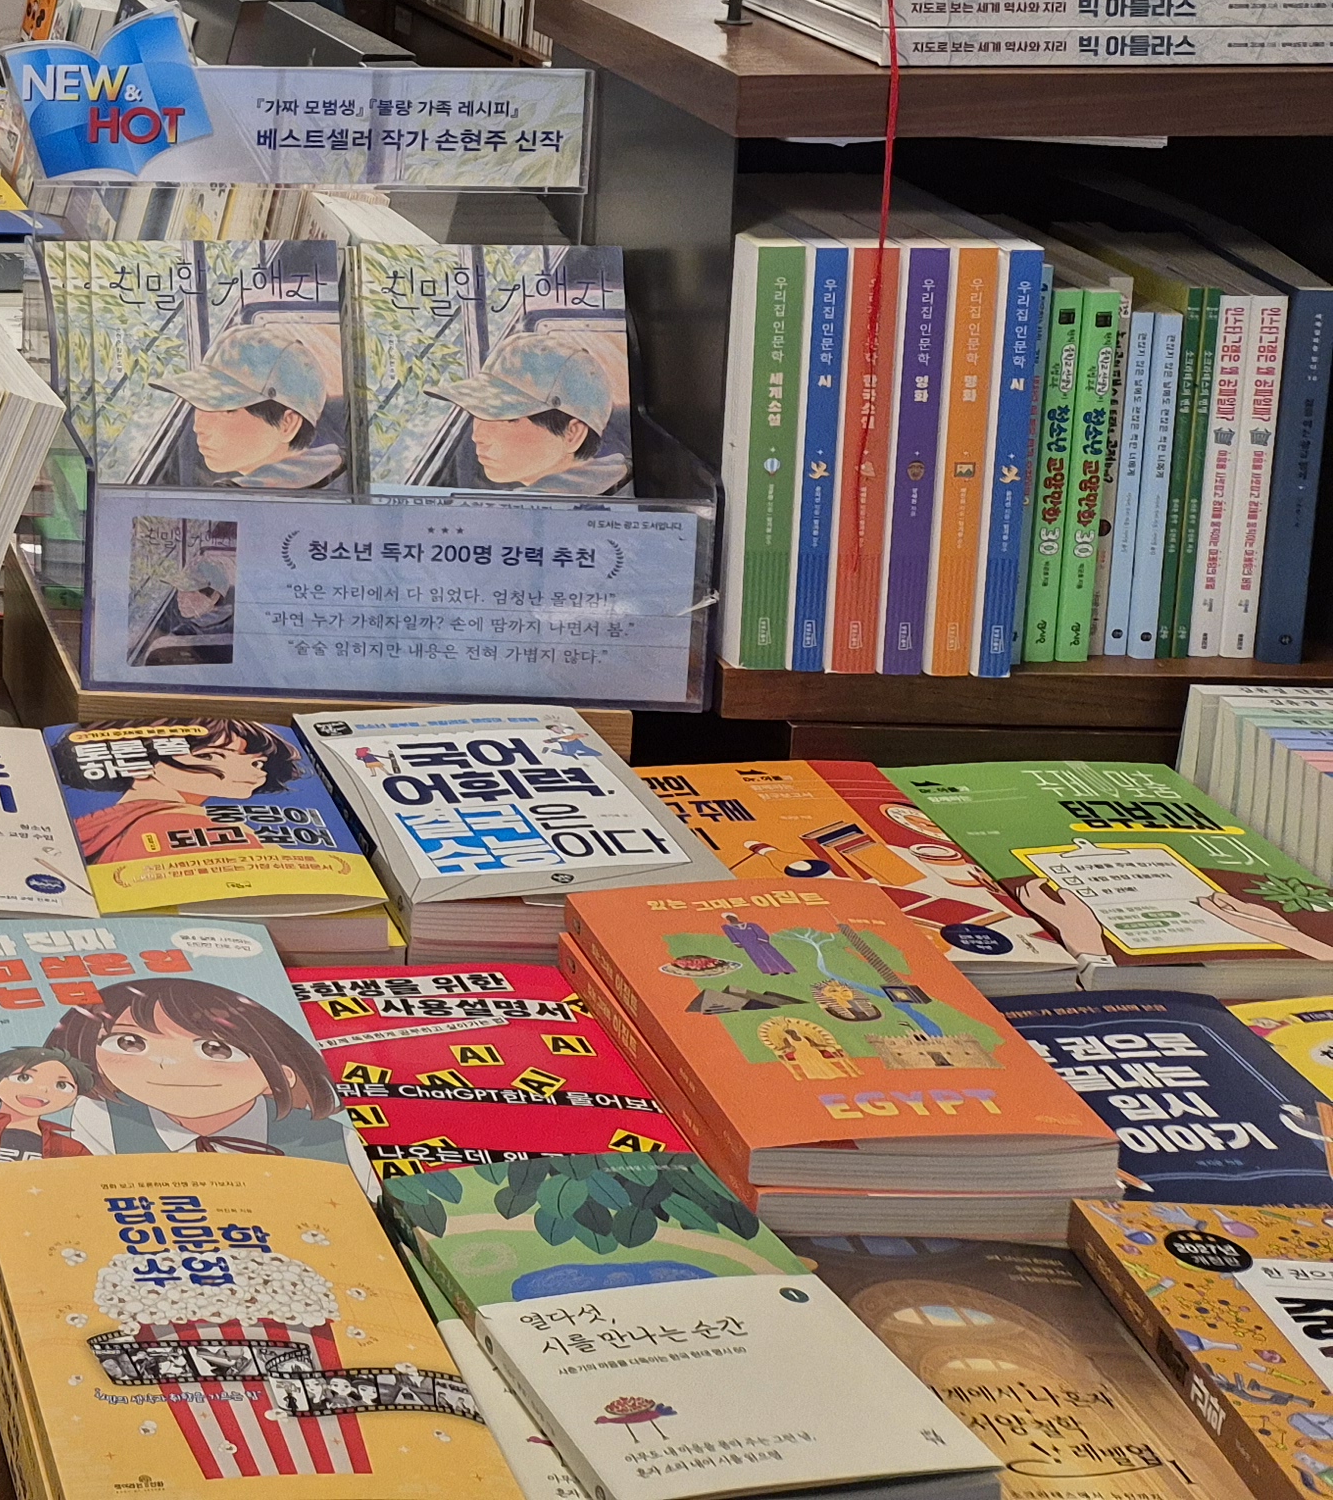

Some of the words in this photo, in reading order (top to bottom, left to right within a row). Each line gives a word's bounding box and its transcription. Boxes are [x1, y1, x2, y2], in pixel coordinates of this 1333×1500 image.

[977, 2, 1001, 14] 세계
[1043, 2, 1067, 14] 지리
[21, 63, 128, 101] NEW
[124, 83, 142, 101] &
[256, 98, 299, 116] 『가짜
[417, 100, 453, 117] 가족
[458, 100, 521, 119] 레시피』
[87, 106, 186, 145] HOT
[256, 128, 373, 151] 베스트셀러
[381, 128, 428, 151] 작가
[435, 129, 508, 152] 손현주
[515, 129, 564, 153] 신작
[109, 259, 203, 311] 친밀한
[212, 259, 328, 308] 가해자
[381, 266, 484, 319] 친밀한
[491, 265, 614, 313] 가해자
[818, 374, 832, 388] 시
[914, 375, 929, 402] 영화
[767, 372, 783, 427] 세계소설
[1214, 378, 1238, 422] 공짜일까?
[1042, 456, 1066, 525] 교양만화
[598, 520, 621, 531] 도서는
[624, 521, 640, 531] 광고
[380, 542, 425, 564] 독자
[430, 544, 493, 566] 200명
[501, 545, 545, 568] 강력
[552, 546, 596, 569] 추천
[1038, 527, 1060, 557] 30
[1073, 528, 1094, 559] 30
[332, 584, 399, 602] 자리에서
[407, 587, 423, 602] 다
[430, 587, 485, 605] 읽었다.
[492, 589, 544, 608] 엄청난
[311, 611, 345, 629] 누가
[350, 614, 444, 631] 가해자일까?
[450, 616, 484, 632] 손에
[491, 617, 543, 635] 땀까지
[549, 619, 600, 637] 나면서
[334, 641, 402, 659] 읽히지만
[408, 643, 459, 661] 내용은
[465, 645, 498, 662] 전혀
[505, 646, 556, 664] 가볍지
[74, 739, 149, 761] 토론
[397, 737, 544, 769] 국어
[83, 760, 156, 781] 하는
[205, 804, 326, 828] 중딩이
[1059, 800, 1226, 832] 탐구보고서
[166, 825, 249, 849] 되고
[254, 826, 338, 848] 싶어
[1191, 835, 1271, 867] 쓰기
[646, 899, 691, 912] 있는
[695, 898, 752, 912] 그대로
[754, 889, 830, 909] 이집트
[39, 953, 136, 979] 싶은
[139, 949, 193, 973] 일
[433, 974, 506, 994] 위한
[329, 999, 370, 1017] AI
[380, 999, 575, 1022] 사용설명서
[551, 1035, 595, 1056] AI
[1055, 1032, 1209, 1061] 권으로
[337, 1082, 389, 1097] 뭐든
[817, 1088, 1003, 1121] EGYPT
[1107, 1091, 1220, 1121] 입시
[1116, 1122, 1279, 1154] 이야기
[377, 1146, 491, 1164] 나오는데
[103, 1195, 208, 1225] 팝콘
[1172, 1242, 1240, 1257] 2027년
[1191, 1254, 1243, 1267] 개정판
[133, 1256, 237, 1289] 수업
[1260, 1265, 1284, 1281] 한
[520, 1303, 616, 1331] 열다섯,
[542, 1333, 596, 1357] 시를
[597, 1325, 689, 1351] 만나는
[691, 1316, 749, 1339] 순간
[733, 1346, 747, 1356] 60
